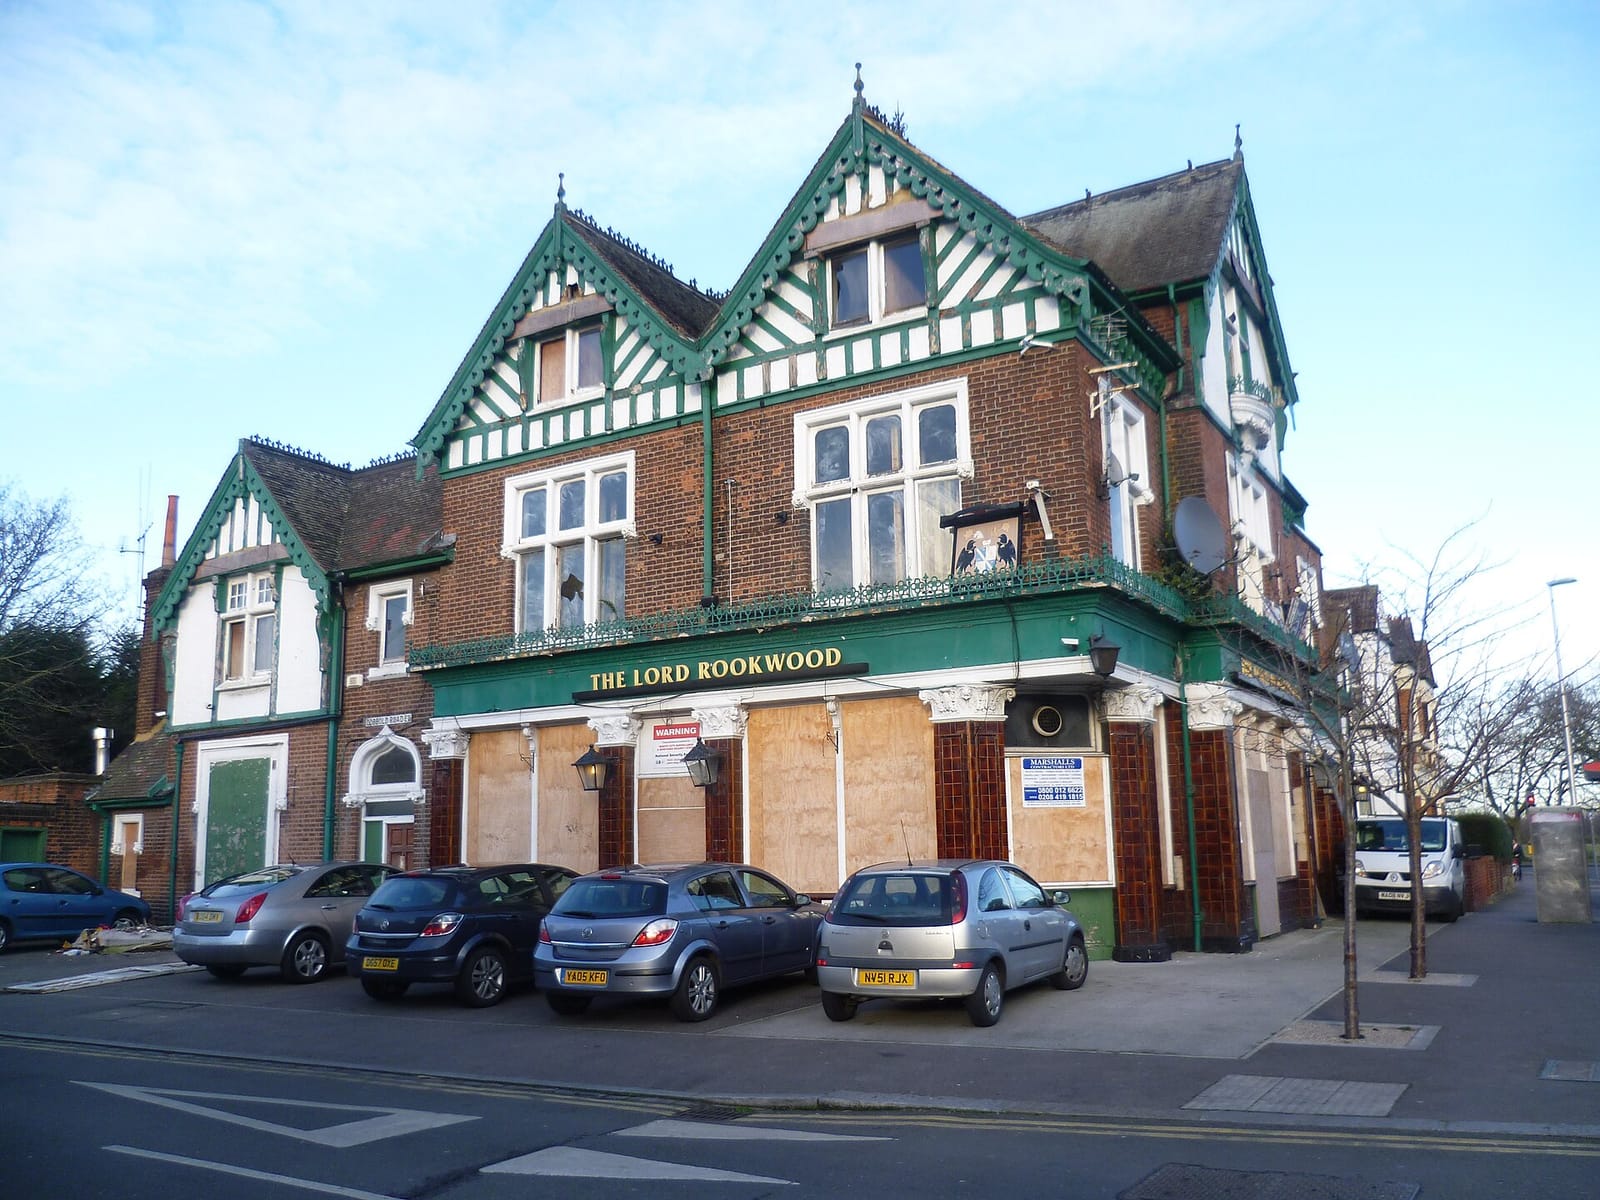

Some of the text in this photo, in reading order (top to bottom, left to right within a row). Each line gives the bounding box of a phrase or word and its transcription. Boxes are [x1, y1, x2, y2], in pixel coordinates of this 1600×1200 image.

[590, 647, 842, 691] THE LORD ROOKWOOD
[655, 727, 697, 737] WARNING
[566, 971, 587, 982] YA05
[864, 972, 908, 984] NV51 RJX
